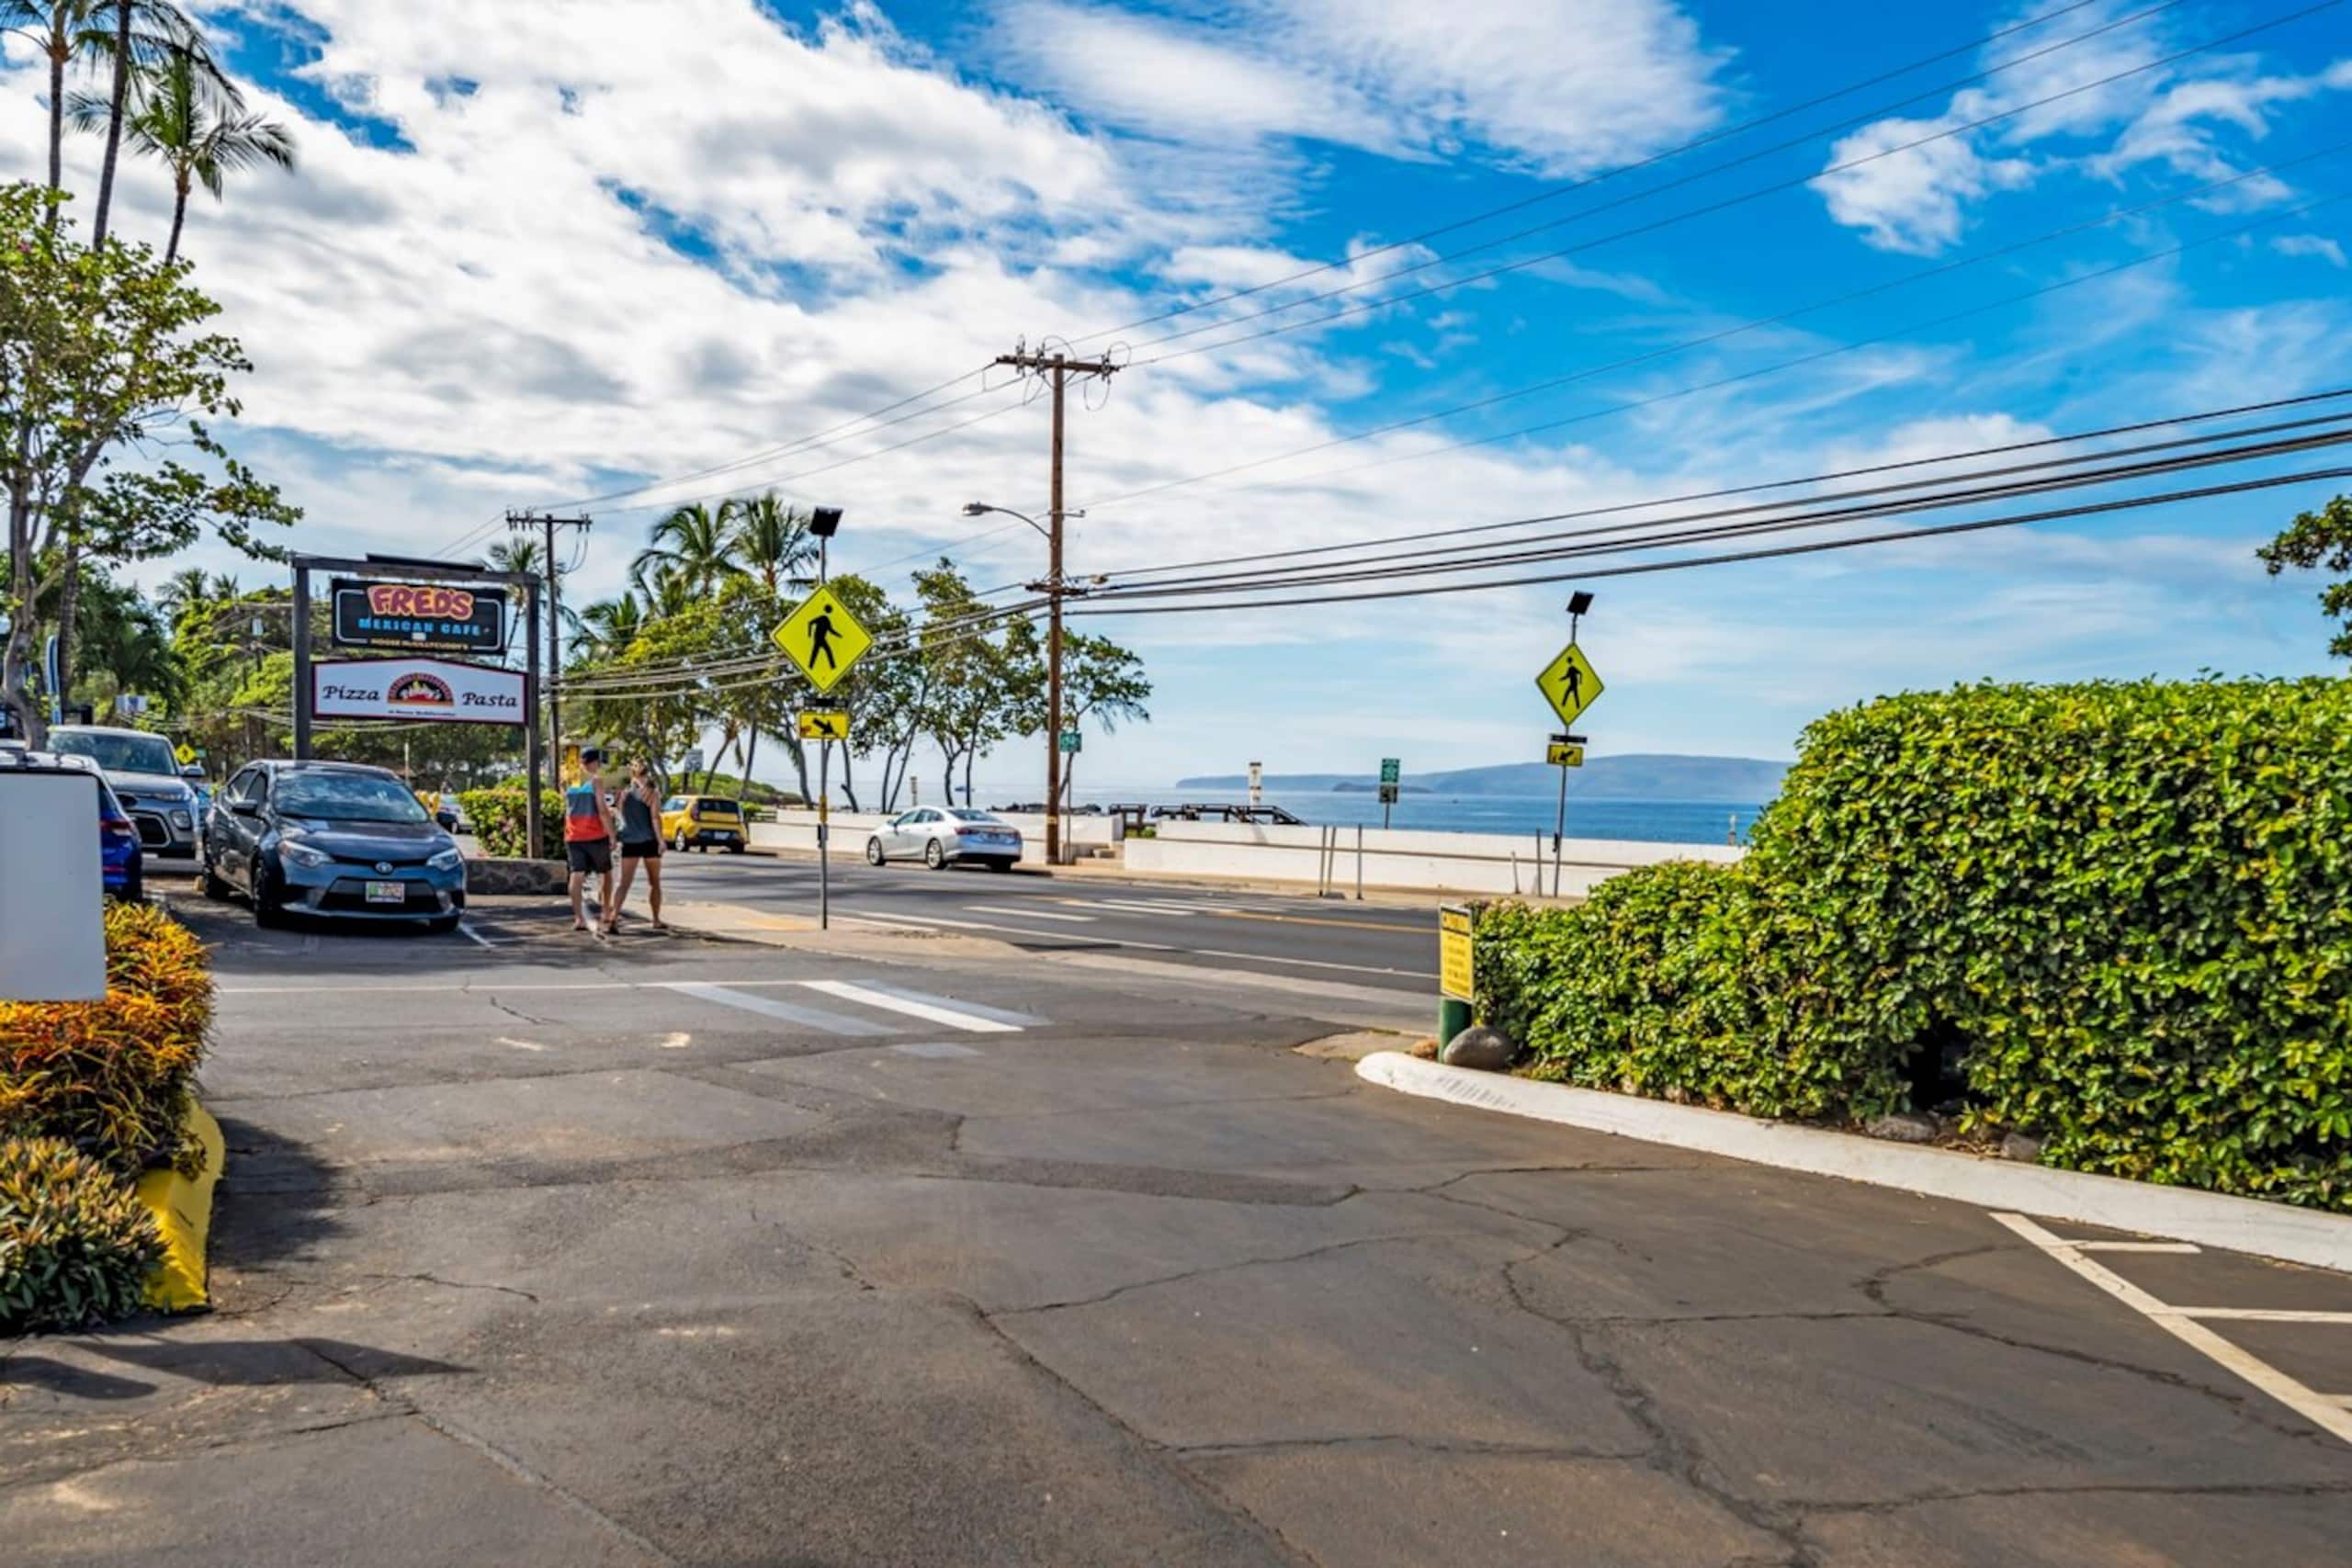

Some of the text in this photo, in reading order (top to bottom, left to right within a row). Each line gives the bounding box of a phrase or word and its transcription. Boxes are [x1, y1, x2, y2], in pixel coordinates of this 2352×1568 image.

[368, 586, 473, 620] FRED'S
[358, 617, 434, 632] MEXICAN
[322, 685, 379, 701] Pizza
[461, 692, 517, 707] Pasta
